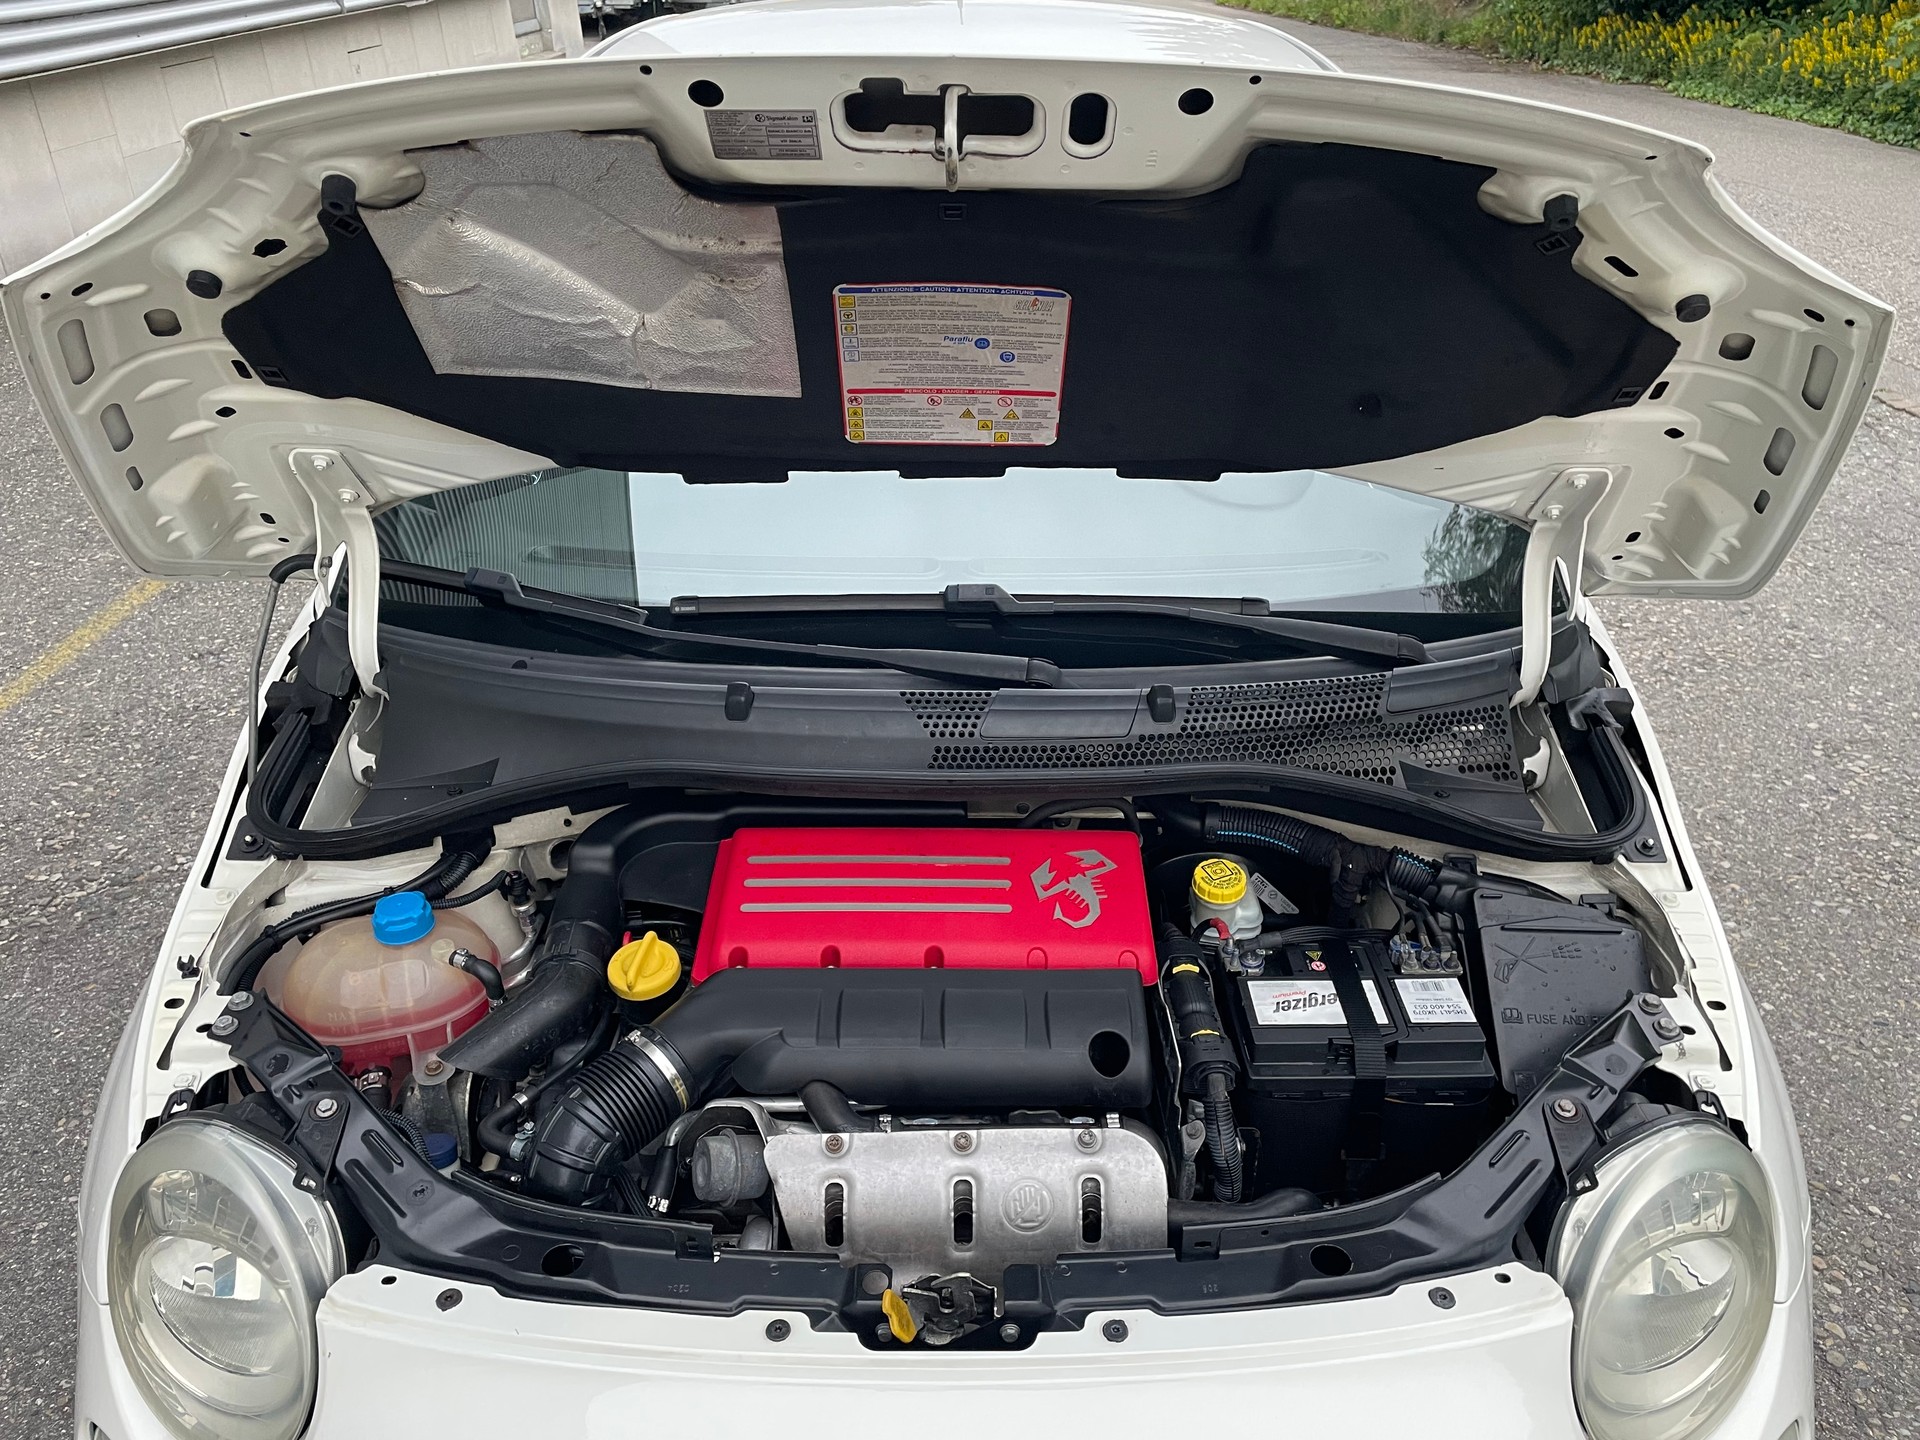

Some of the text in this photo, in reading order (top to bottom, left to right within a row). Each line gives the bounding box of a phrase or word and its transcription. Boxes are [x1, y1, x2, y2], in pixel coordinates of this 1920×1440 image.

[1272, 990, 1307, 999] Premium
[1273, 992, 1338, 1014] ergizer
[1526, 1013, 1558, 1025] FUSE
[1562, 1015, 1586, 1026] AND
